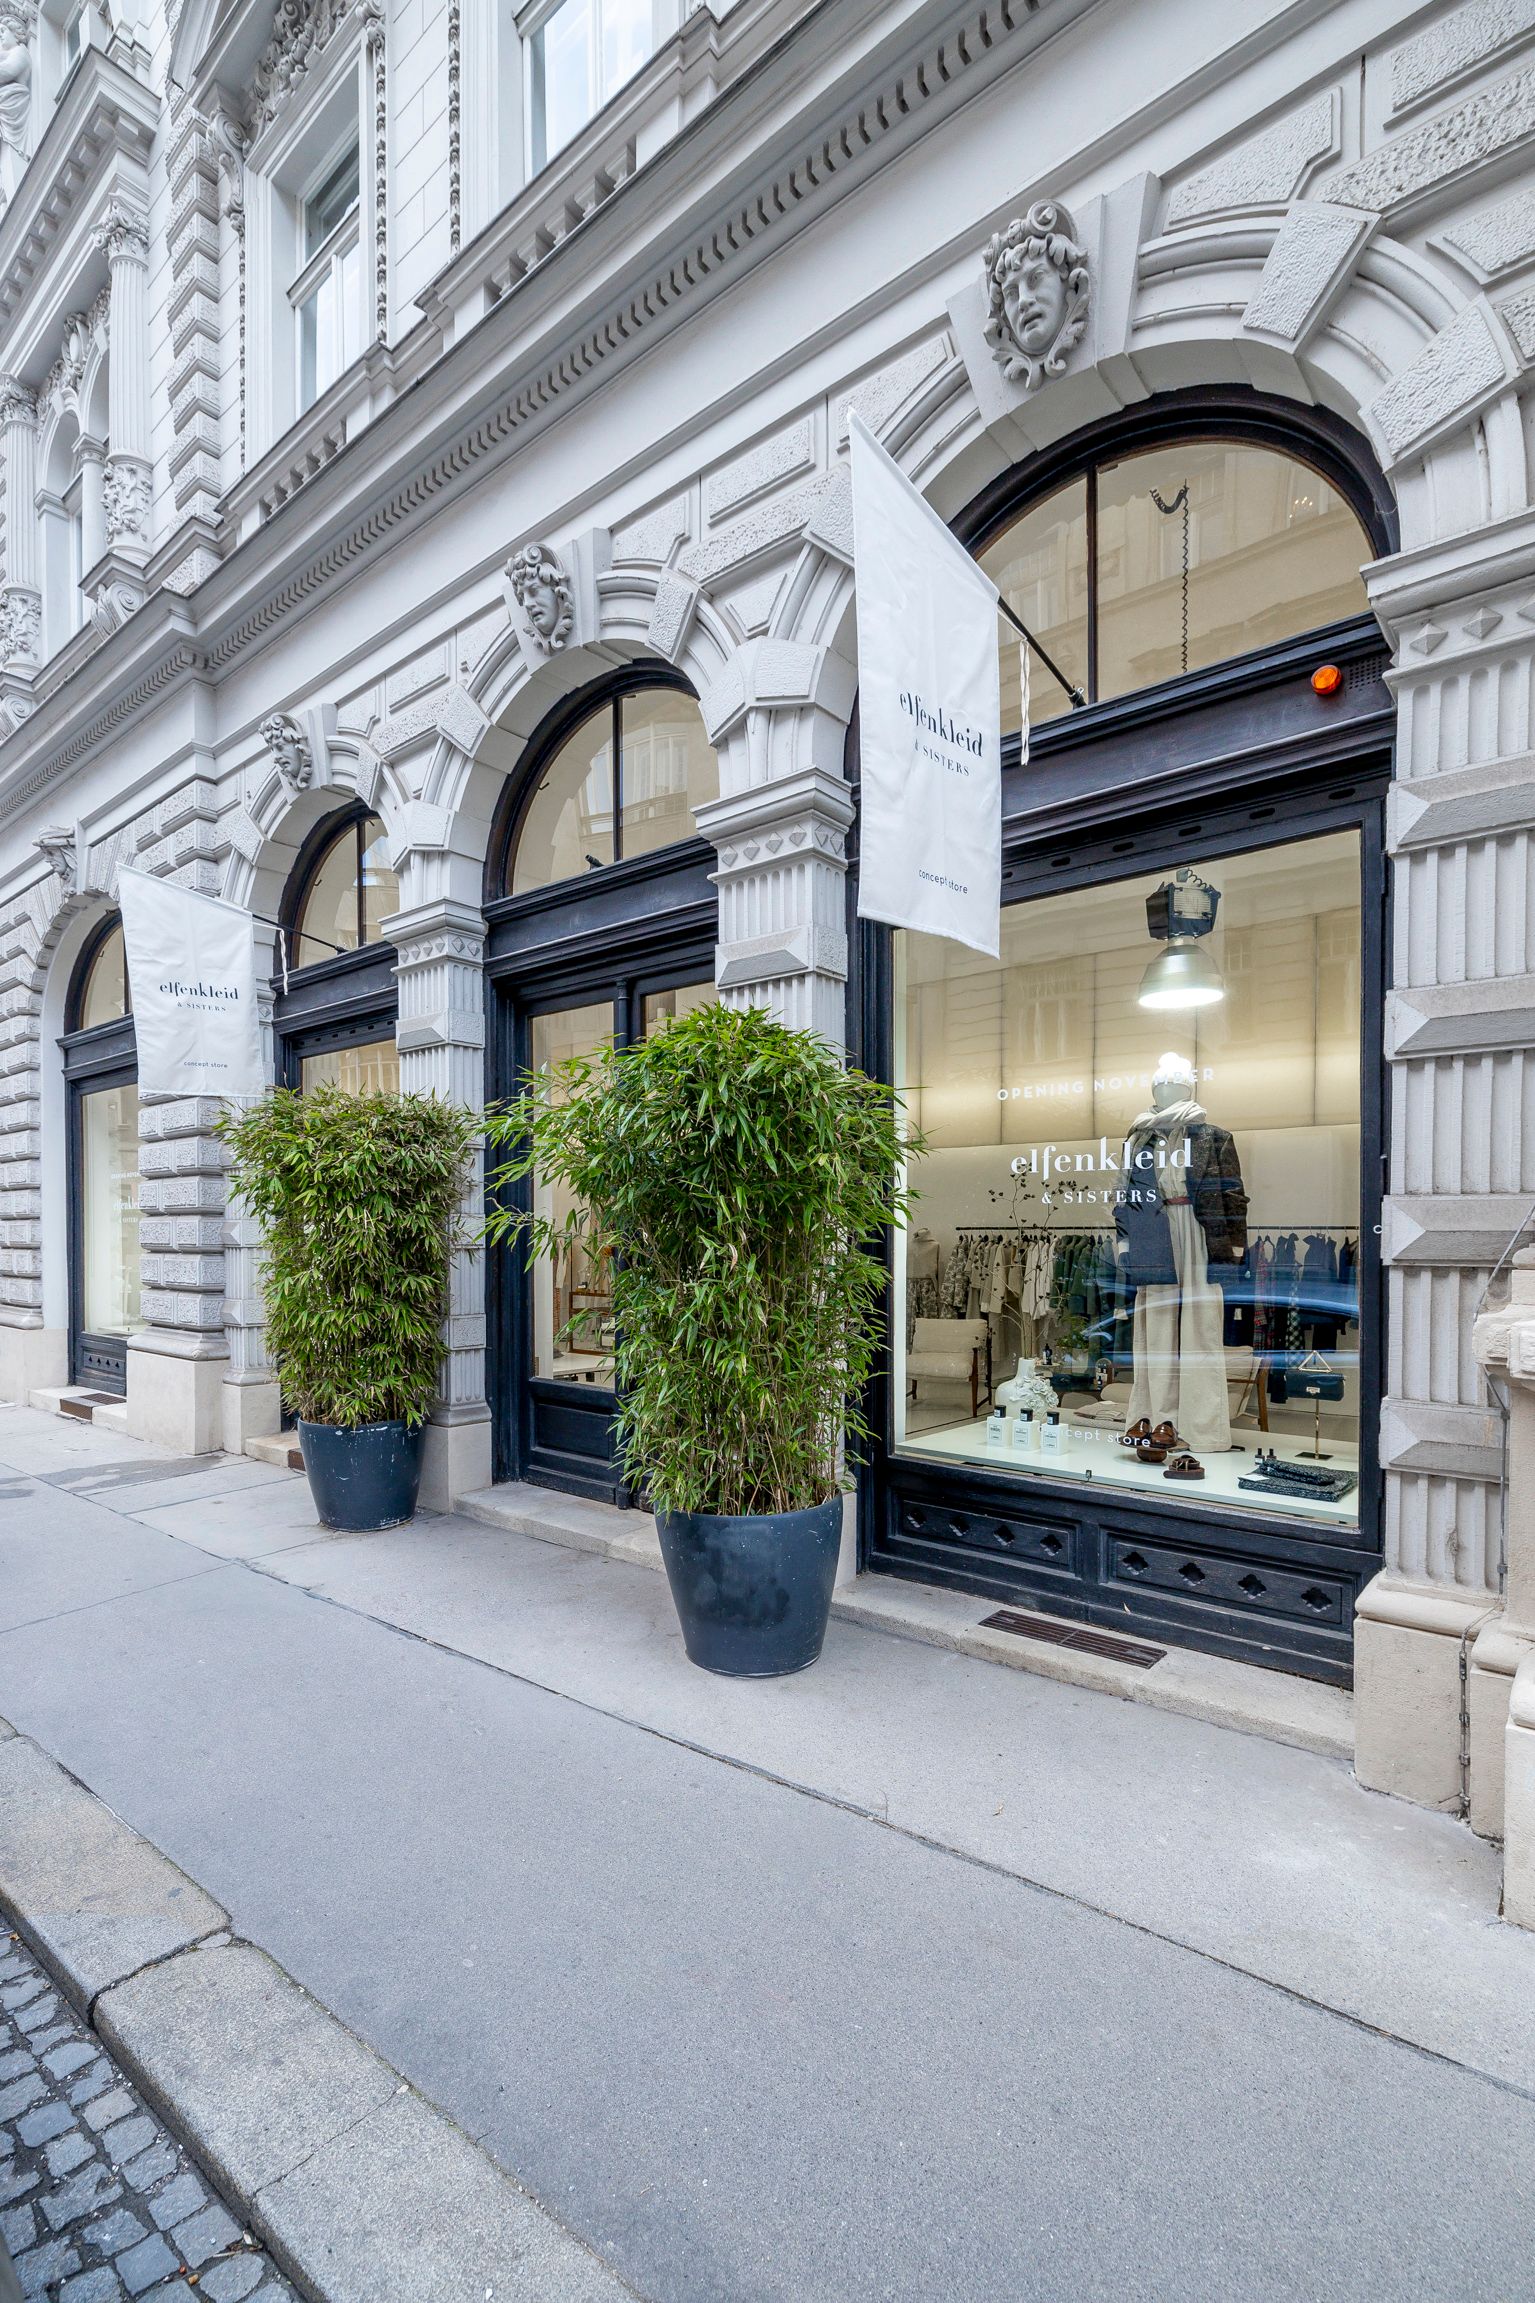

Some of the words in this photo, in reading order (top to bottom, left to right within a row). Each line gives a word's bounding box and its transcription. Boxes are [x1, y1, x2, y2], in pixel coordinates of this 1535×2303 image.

[899, 692, 983, 758] elfenkleid
[923, 746, 970, 777] SISTERS
[160, 981, 239, 1000] elfenkleid
[186, 1002, 227, 1012] SISTERS
[183, 1060, 209, 1069] concept
[997, 1081, 1084, 1101] OPENING
[1094, 1067, 1215, 1092] NOVEMBER
[1010, 1136, 1193, 1181] elfenkleid
[1041, 1192, 1053, 1204] &
[1063, 1189, 1157, 1204] SISTERS
[1107, 1432, 1151, 1448] store
